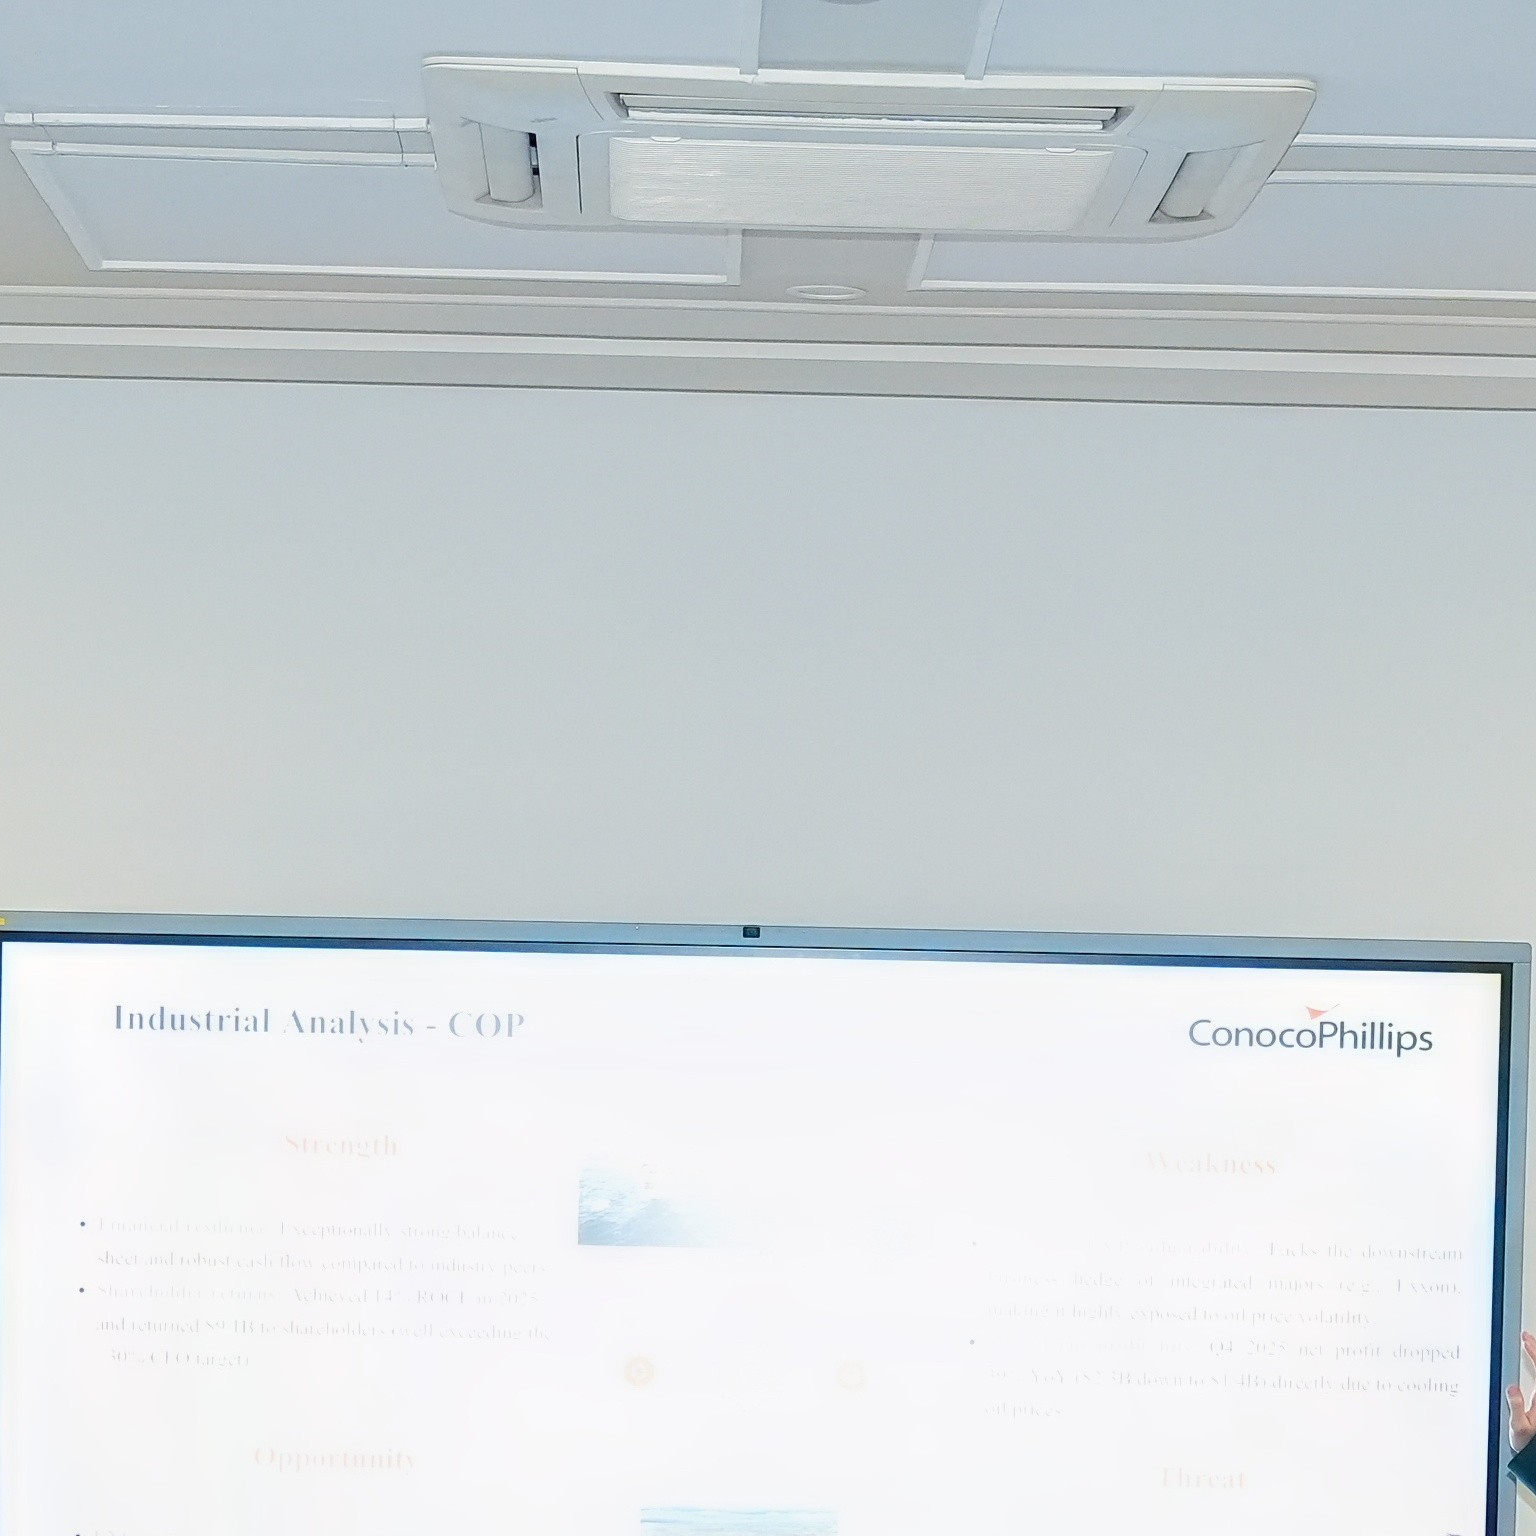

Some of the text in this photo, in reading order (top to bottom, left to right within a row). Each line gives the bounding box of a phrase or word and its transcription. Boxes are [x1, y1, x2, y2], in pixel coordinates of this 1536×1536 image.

[114, 1005, 269, 1034] Industrial
[283, 1009, 415, 1043] Analysis
[448, 1011, 525, 1038] COP
[1188, 1018, 1434, 1058] ConocoPhillips
[284, 1134, 399, 1158] Strength
[1392, 1342, 1461, 1363] dropped
[1397, 1377, 1460, 1398] cooling
[255, 1447, 416, 1475] Opportunity
[1162, 1466, 1247, 1489] Threat
